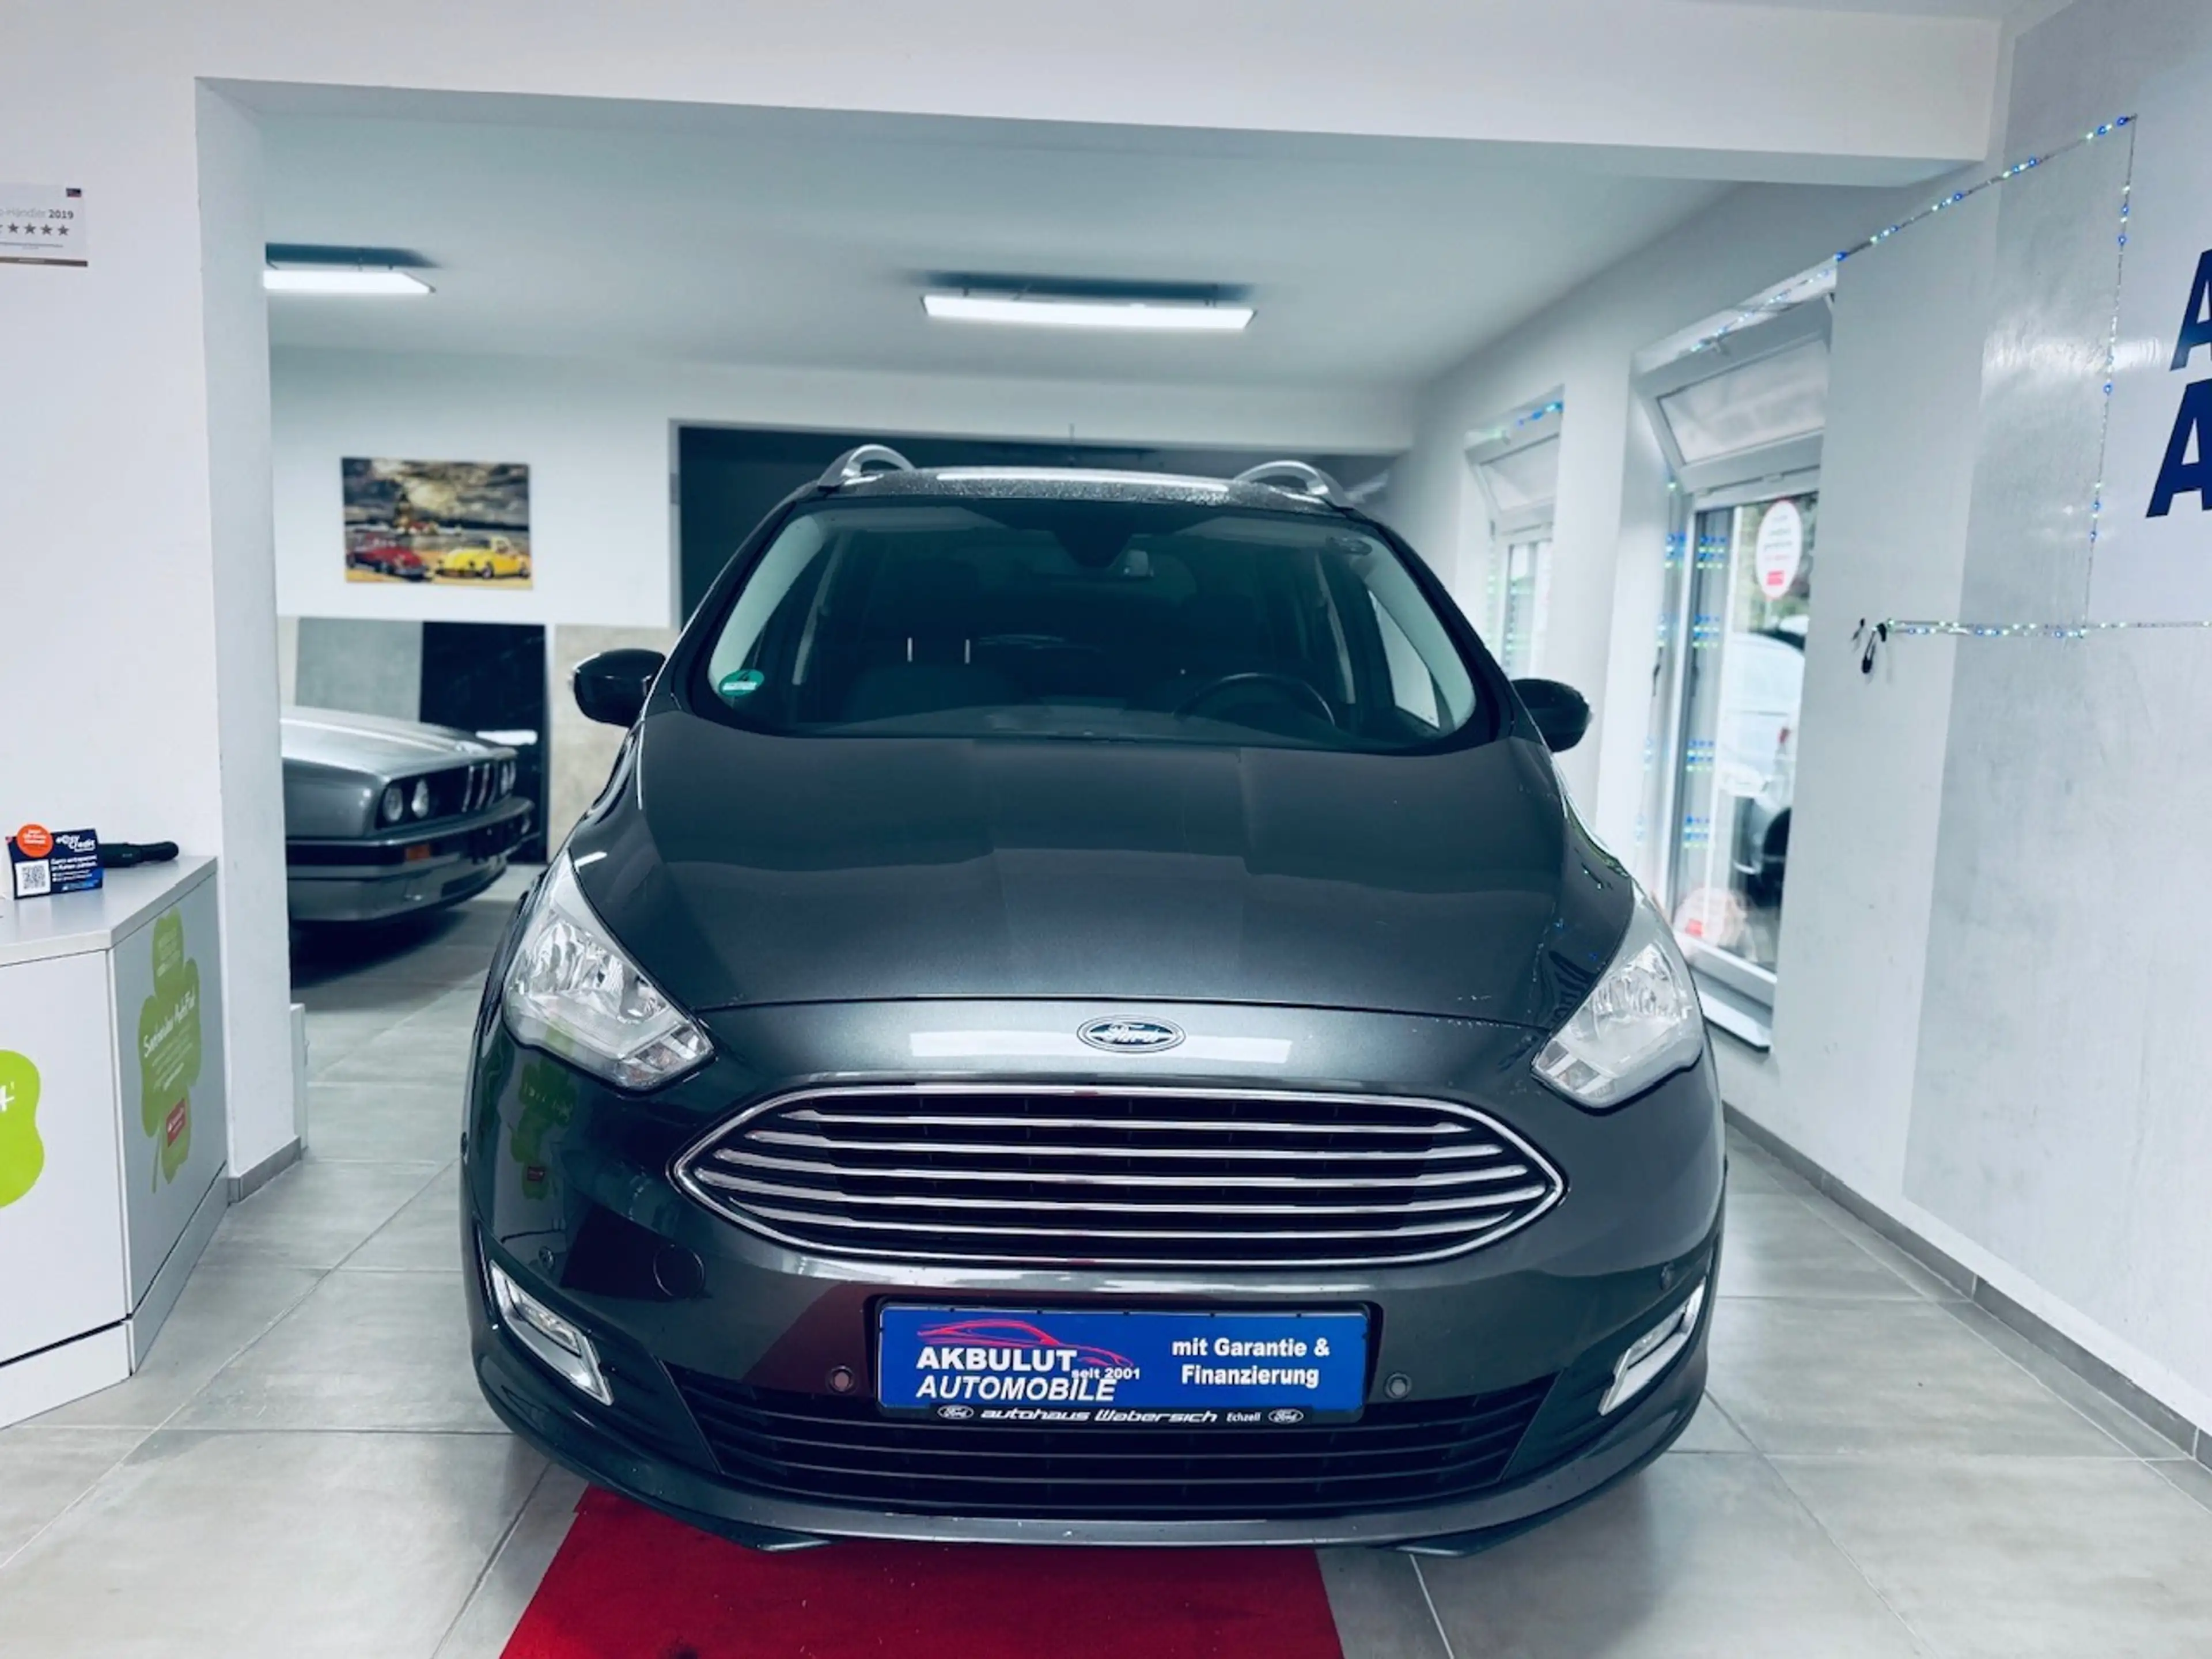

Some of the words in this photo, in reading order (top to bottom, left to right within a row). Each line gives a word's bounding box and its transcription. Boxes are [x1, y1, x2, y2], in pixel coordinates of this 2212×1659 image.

[48, 209, 74, 219] 2019
[1172, 1338, 1208, 1356] mit
[1214, 1338, 1307, 1357] Garantie
[1314, 1338, 1330, 1357] &
[916, 1346, 1077, 1372] AKBULUT
[1071, 1368, 1099, 1380] seit
[1104, 1368, 1141, 1380] 2001
[1181, 1364, 1320, 1389] Finanzierung
[916, 1375, 1118, 1402] AUTOMOBILE
[980, 1408, 1090, 1421] autohaus
